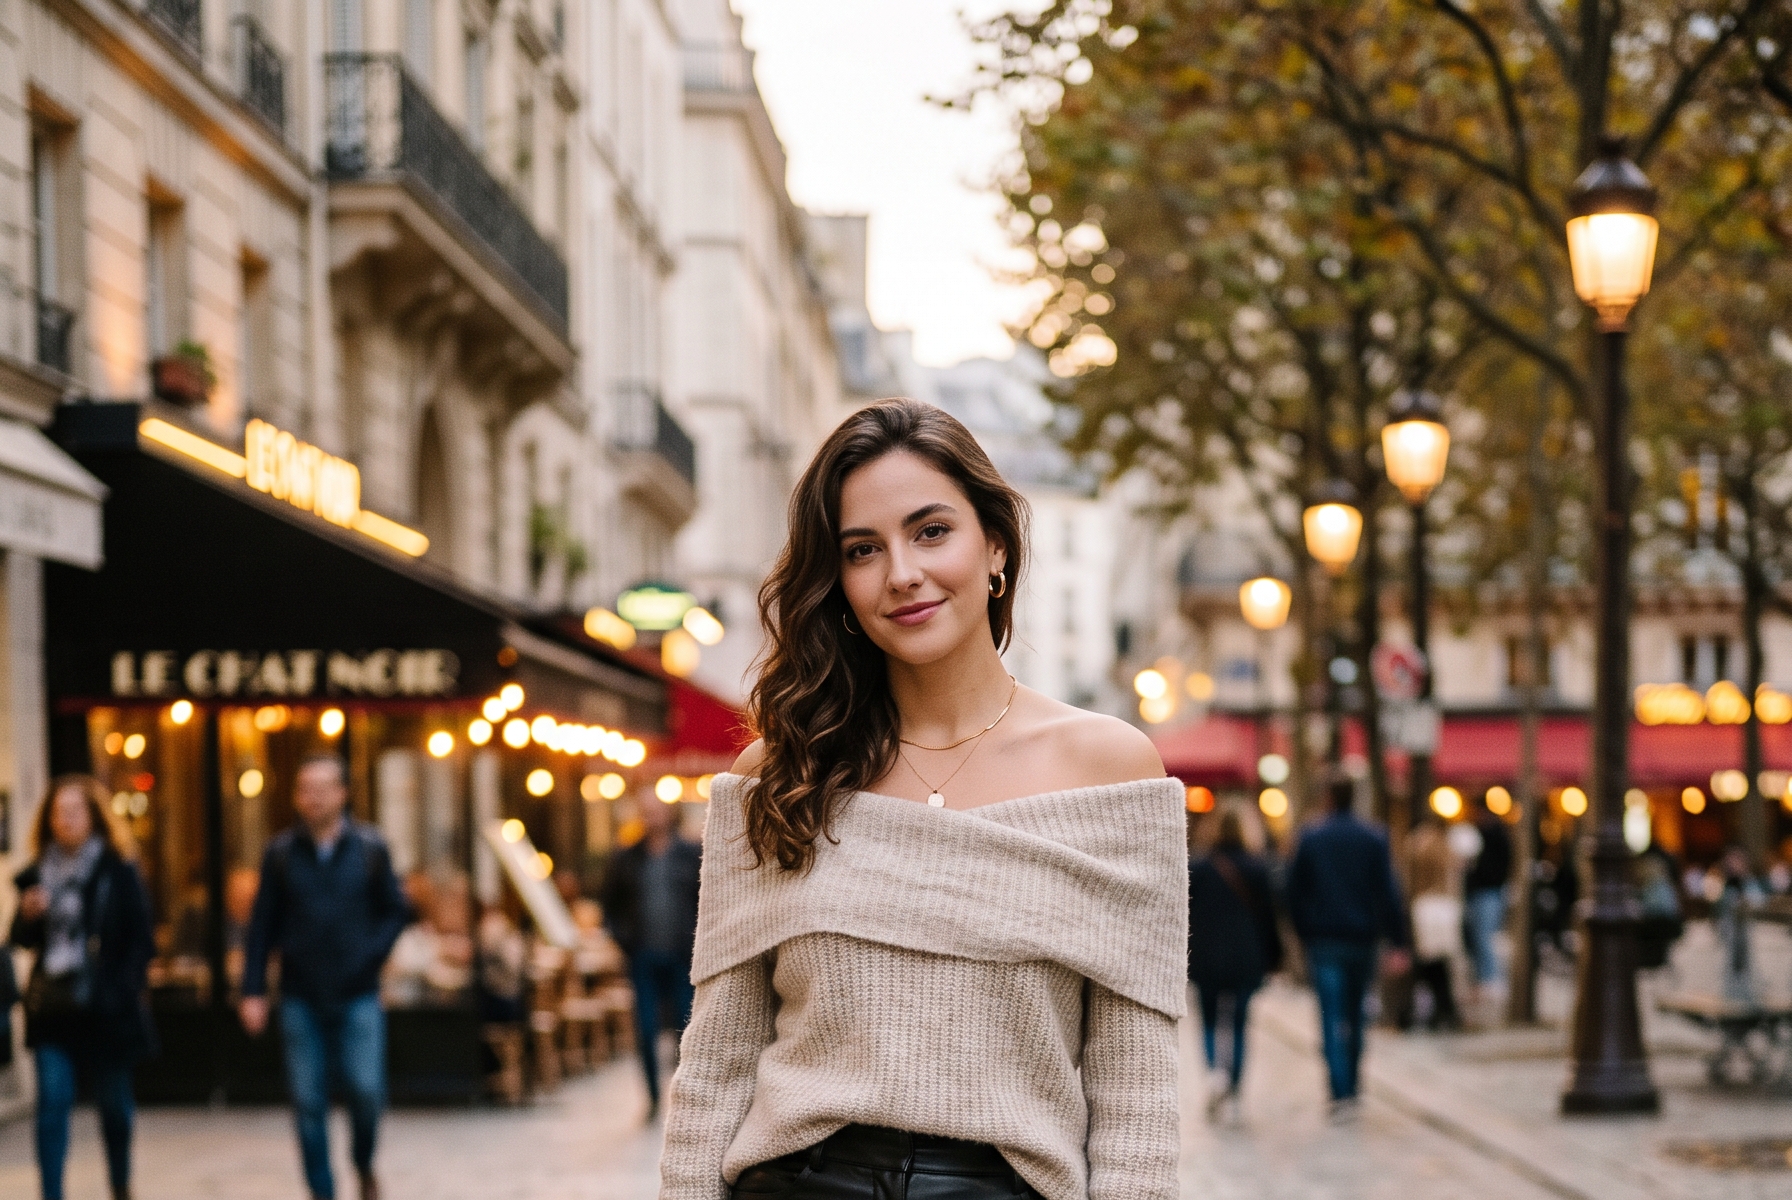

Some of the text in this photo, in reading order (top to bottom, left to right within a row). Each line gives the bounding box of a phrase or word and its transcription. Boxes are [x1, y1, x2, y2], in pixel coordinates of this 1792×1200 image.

[110, 648, 461, 697] LE CHAT NOIR
